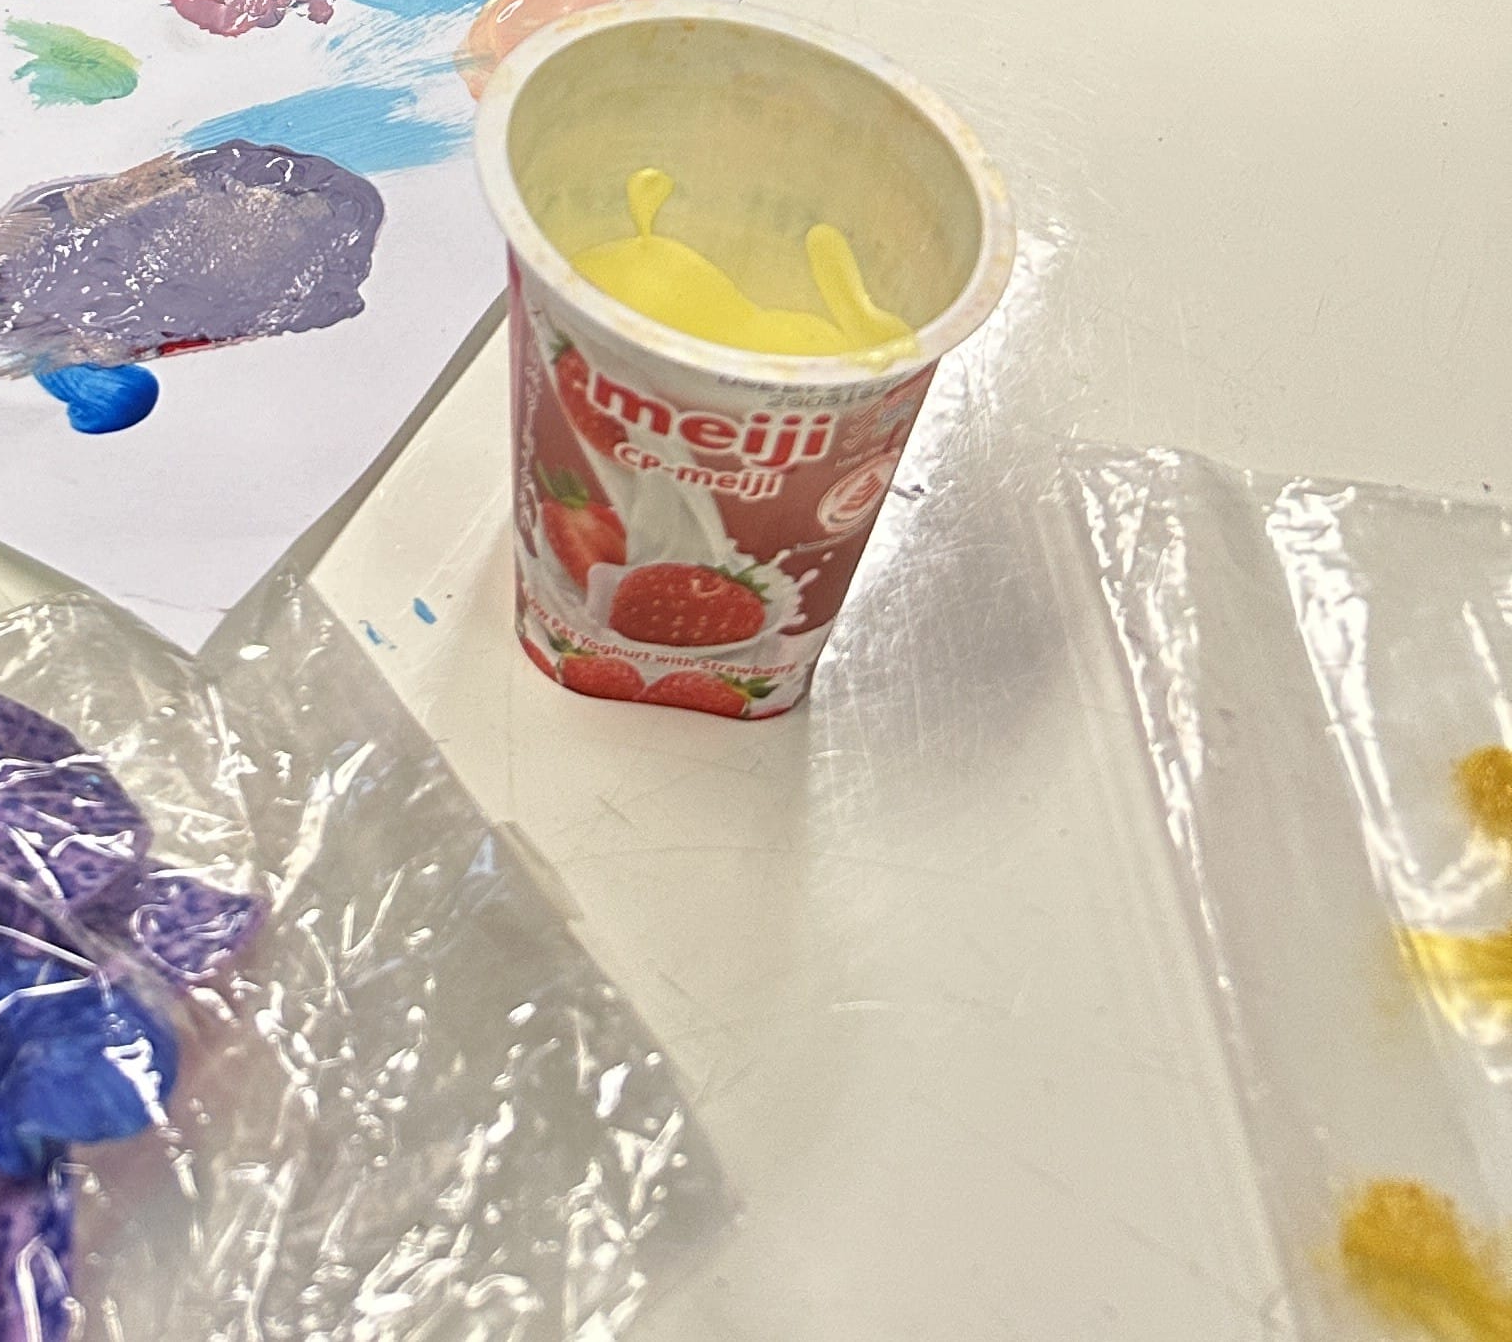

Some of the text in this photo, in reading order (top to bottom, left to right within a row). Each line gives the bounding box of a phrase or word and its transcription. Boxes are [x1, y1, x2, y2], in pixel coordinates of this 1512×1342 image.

[590, 374, 835, 469] meiji
[616, 441, 785, 500] CP-meiji
[551, 617, 577, 642] Fat
[579, 633, 653, 664] Yoghurt
[655, 651, 696, 668] with
[698, 658, 798, 678] Strawberry
